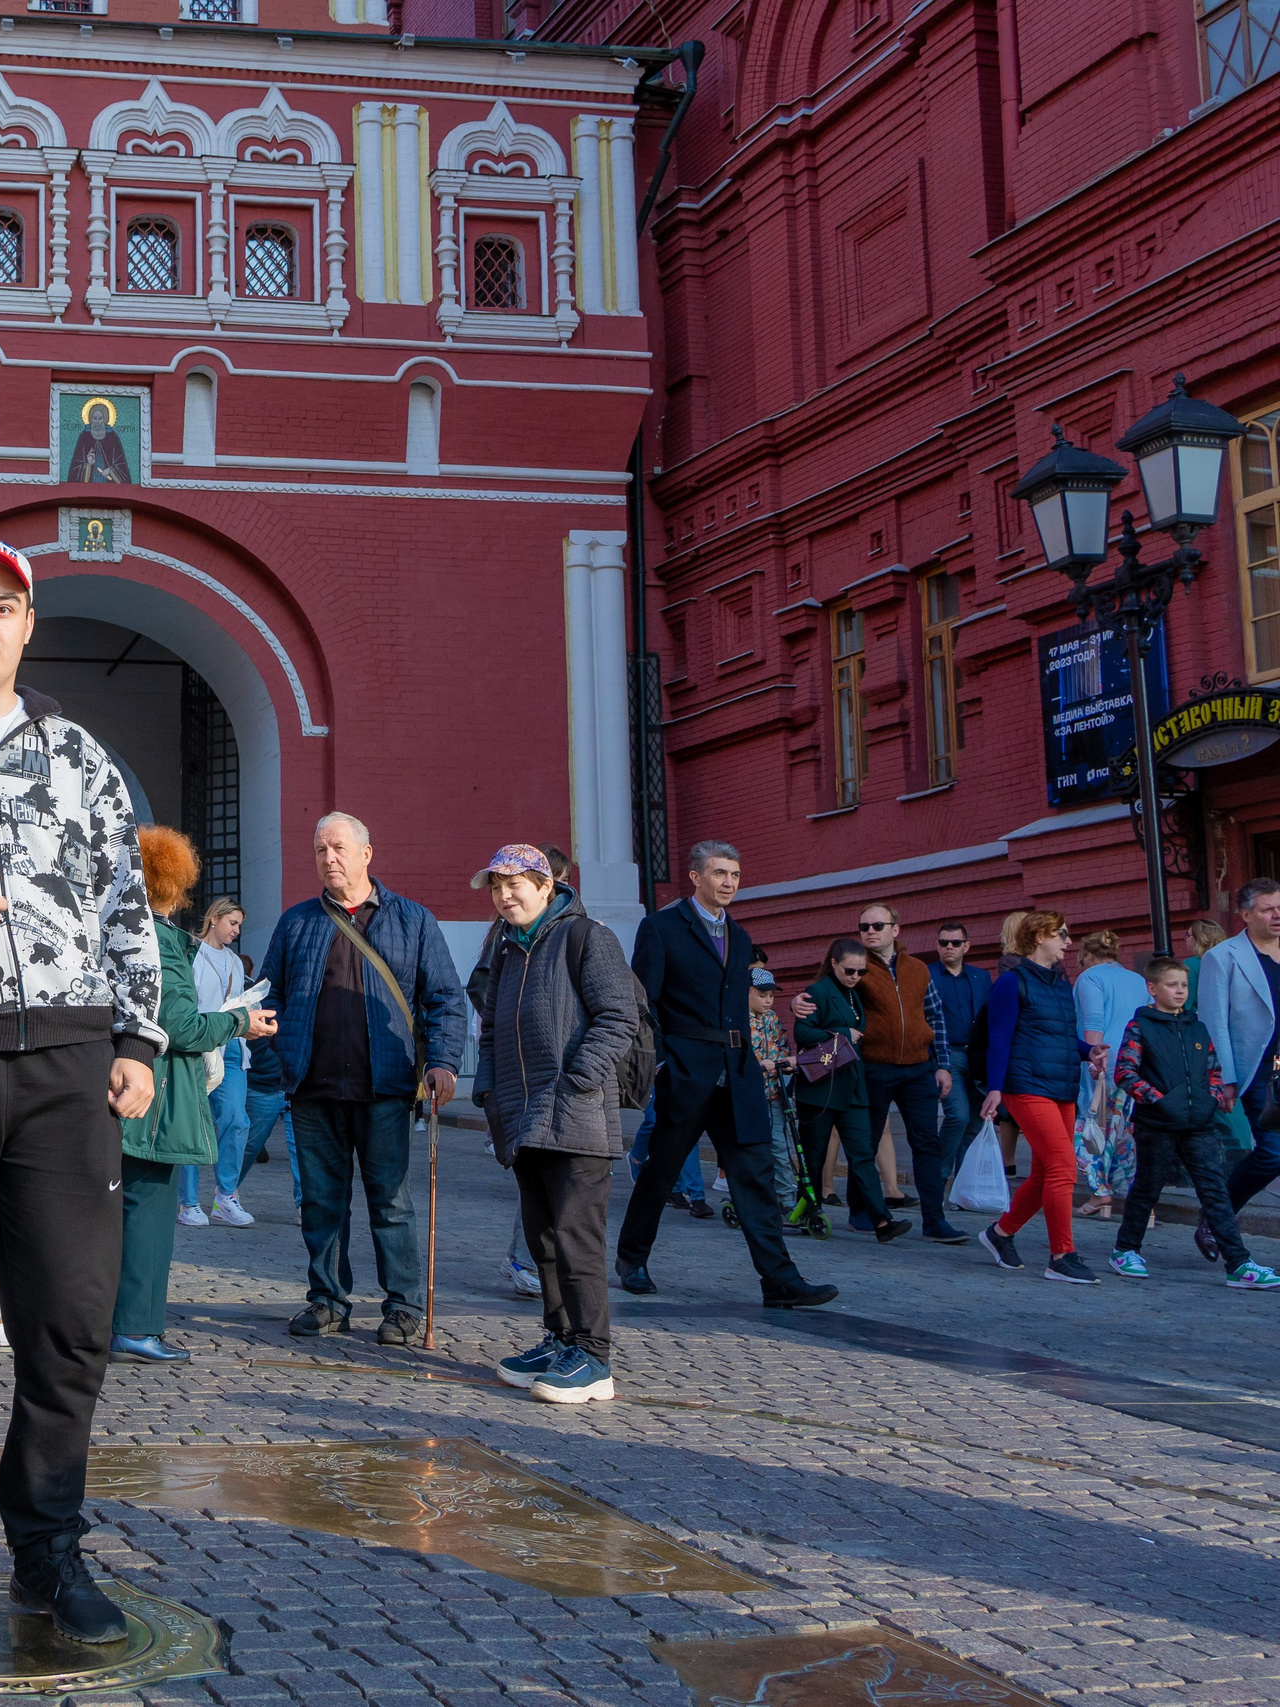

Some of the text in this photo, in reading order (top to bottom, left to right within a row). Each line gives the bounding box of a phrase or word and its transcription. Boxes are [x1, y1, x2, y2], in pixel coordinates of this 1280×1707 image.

[1048, 646, 1058, 657] 17
[1060, 640, 1079, 654] МАЯ
[1090, 633, 1100, 644] 31
[1049, 649, 1096, 671] 2023 ГОДА
[1053, 694, 1133, 724] МЕДИА ВЫСТАВКА
[1054, 713, 1115, 737] «ЗА ЛЕНТОЙ»
[1134, 693, 1263, 757] СТАВОЧНЫЙ
